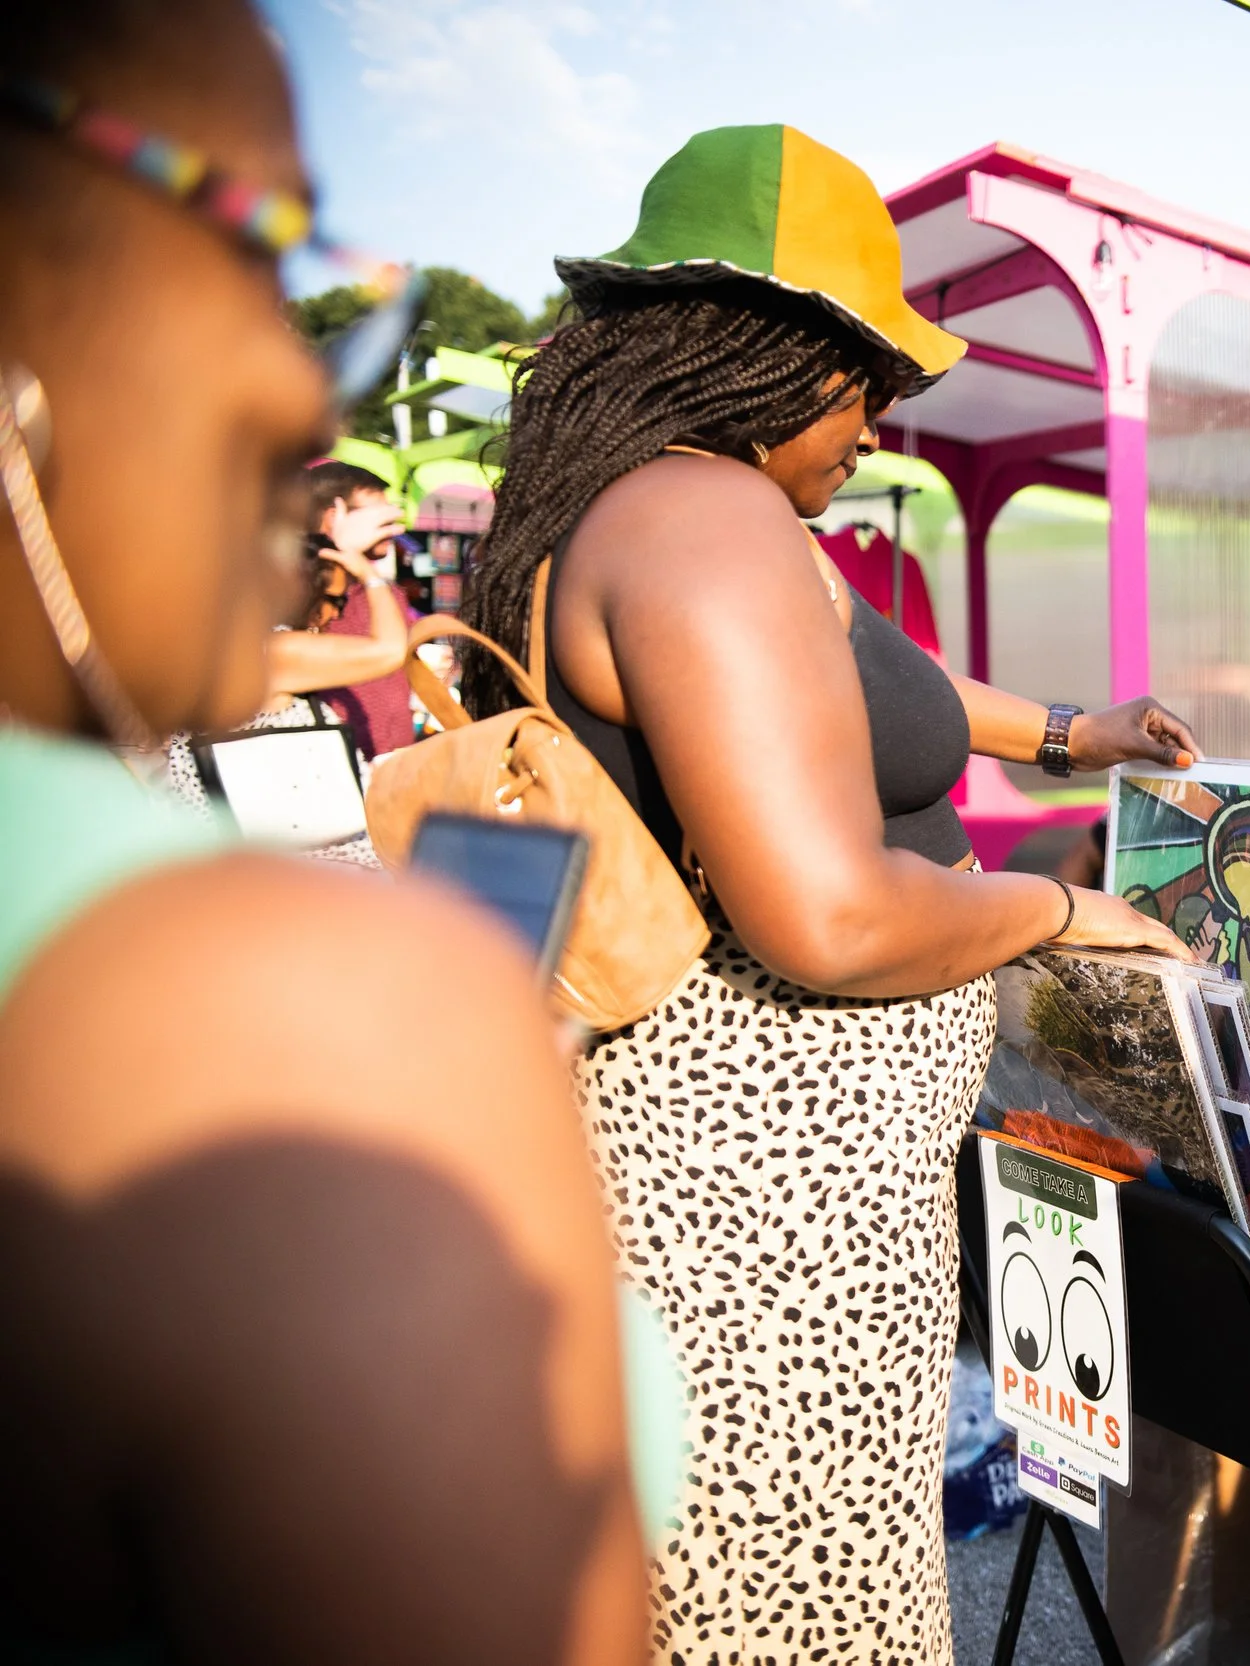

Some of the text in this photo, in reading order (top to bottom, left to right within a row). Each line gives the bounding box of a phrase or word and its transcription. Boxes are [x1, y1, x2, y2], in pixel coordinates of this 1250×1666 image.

[1002, 1158, 1089, 1205] COME TAKE A
[1018, 1196, 1084, 1247] LOOK
[1003, 1365, 1121, 1449] PRINTS
[1022, 1446, 1038, 1459] Cash
[1039, 1455, 1054, 1467] App
[1026, 1461, 1051, 1480] Zelle
[1068, 1463, 1096, 1481] PayPal
[1070, 1483, 1095, 1501] Square
